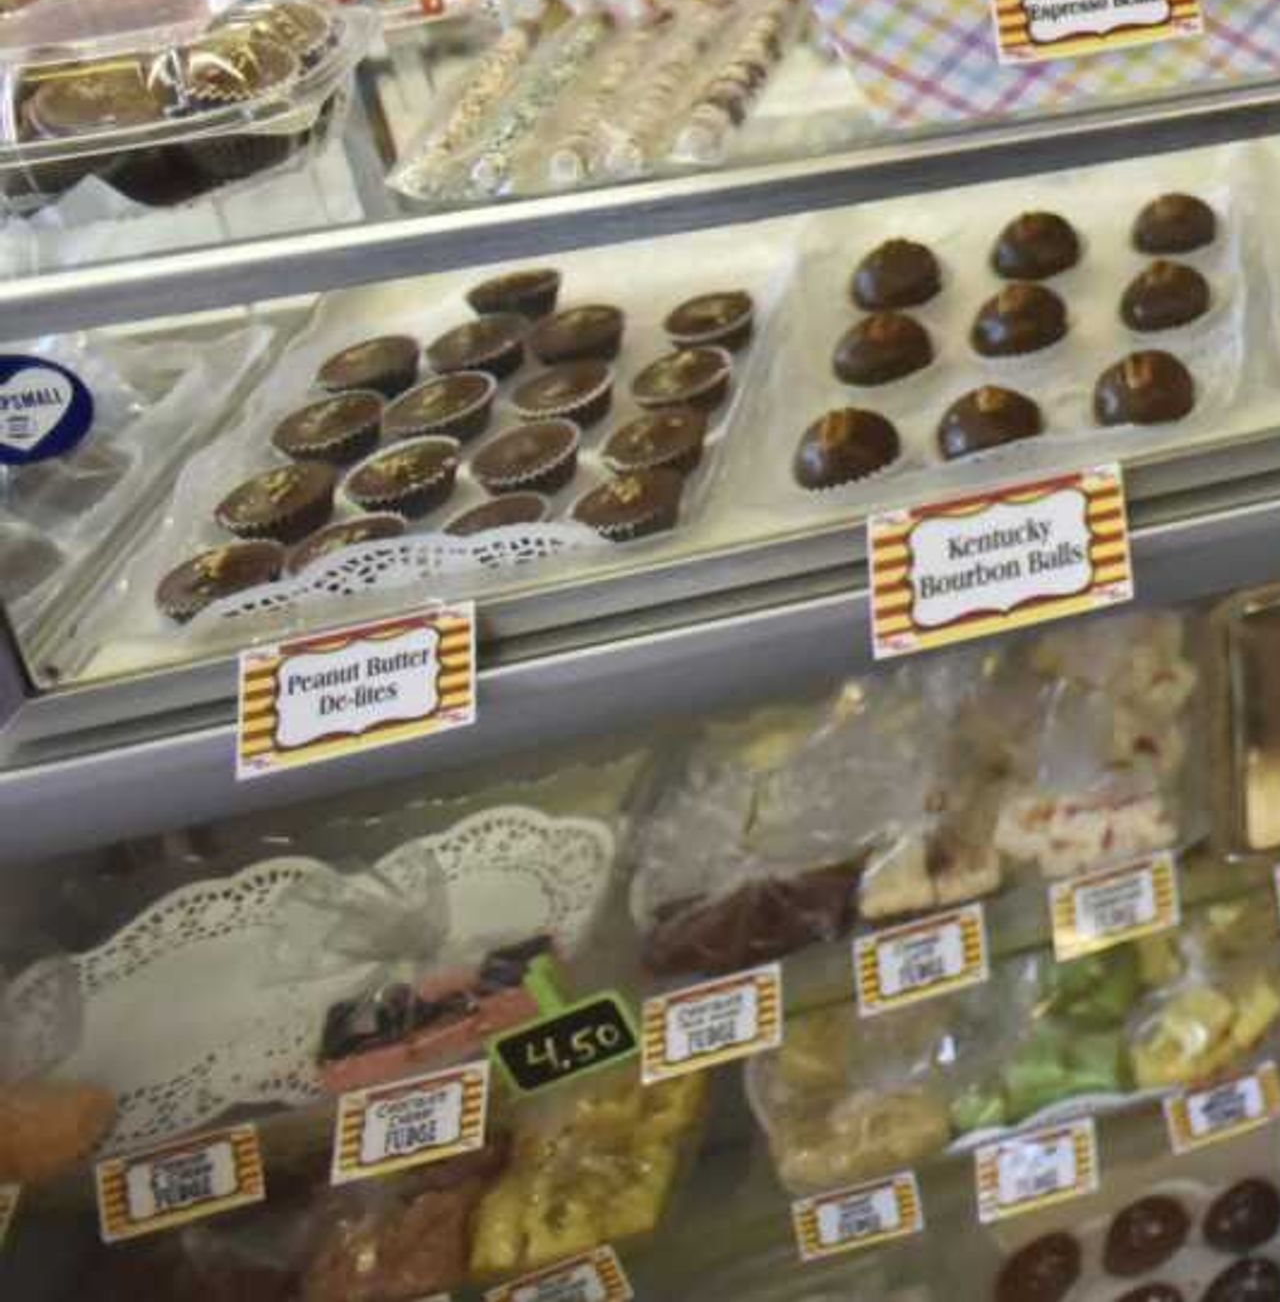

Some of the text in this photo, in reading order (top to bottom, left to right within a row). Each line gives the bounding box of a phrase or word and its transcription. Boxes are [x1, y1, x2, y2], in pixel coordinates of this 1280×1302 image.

[947, 517, 1054, 561] Kentucky
[919, 541, 1085, 599] Bourbon Balls
[287, 648, 430, 696] Peanut Butter
[318, 681, 398, 716] De-lites
[525, 1023, 619, 1070] 4.50
